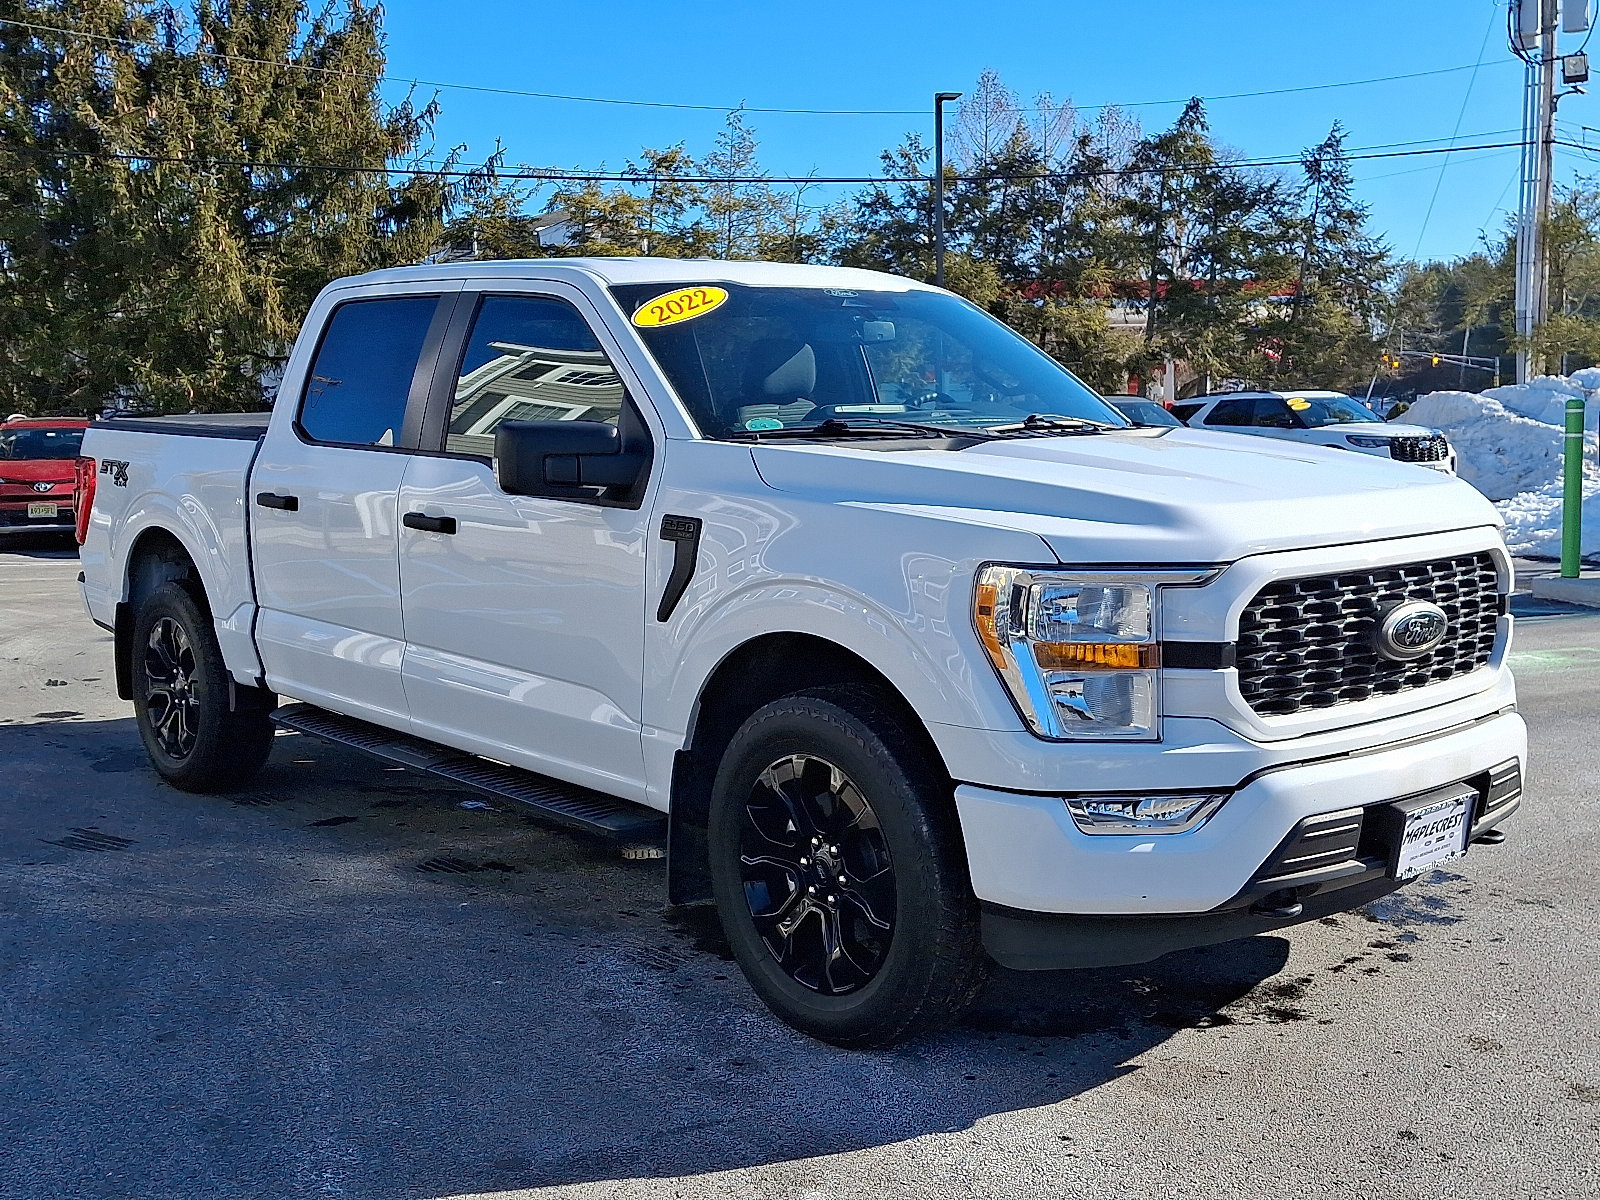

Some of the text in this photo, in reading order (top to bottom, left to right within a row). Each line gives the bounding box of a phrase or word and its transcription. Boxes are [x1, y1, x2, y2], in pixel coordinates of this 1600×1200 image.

[650, 289, 714, 323] 2022
[99, 459, 130, 481] STX
[1405, 617, 1440, 645] Ford
[1402, 811, 1467, 846] MAPLECREST
